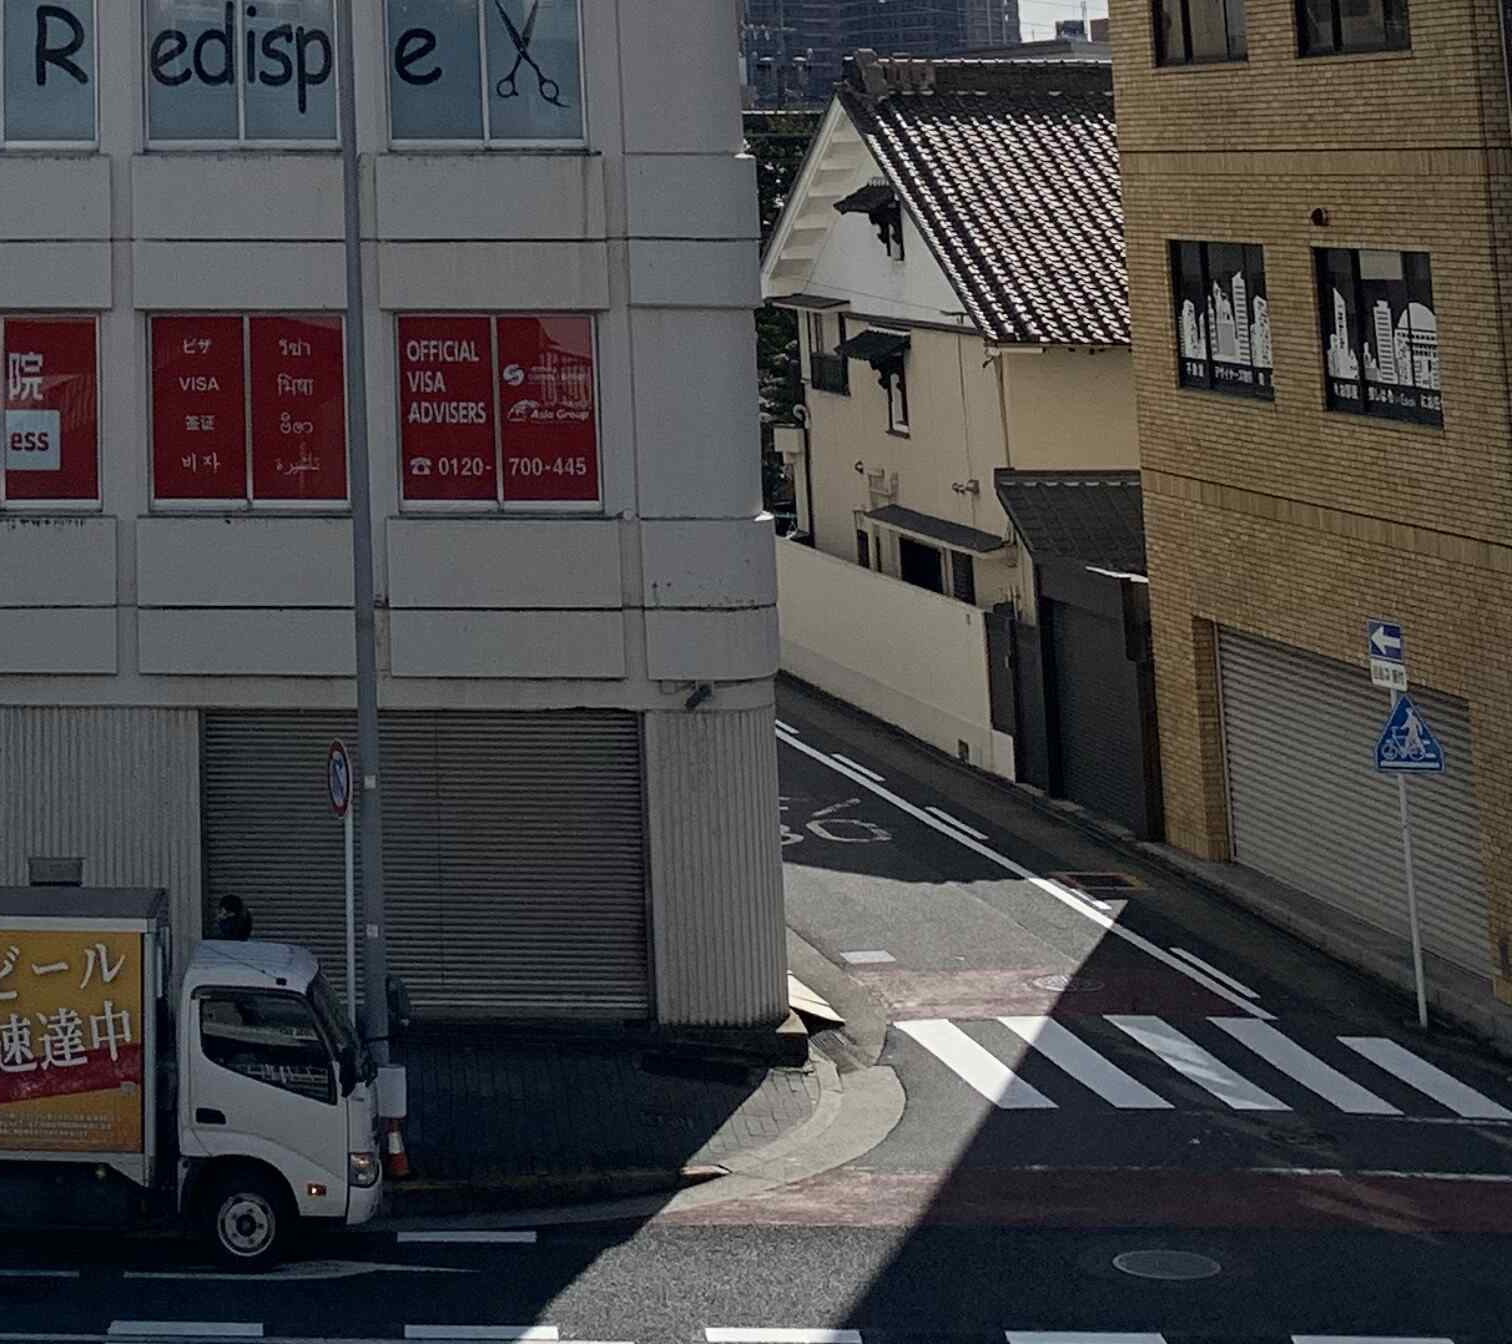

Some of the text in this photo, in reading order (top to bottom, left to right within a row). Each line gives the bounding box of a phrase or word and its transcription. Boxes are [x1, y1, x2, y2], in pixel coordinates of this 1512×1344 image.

[407, 340, 480, 363] OFFICIAL
[179, 376, 220, 392] VISA
[408, 372, 447, 392] VISA
[408, 402, 487, 423] ADVISERS
[438, 456, 587, 476] 0120-700-445
